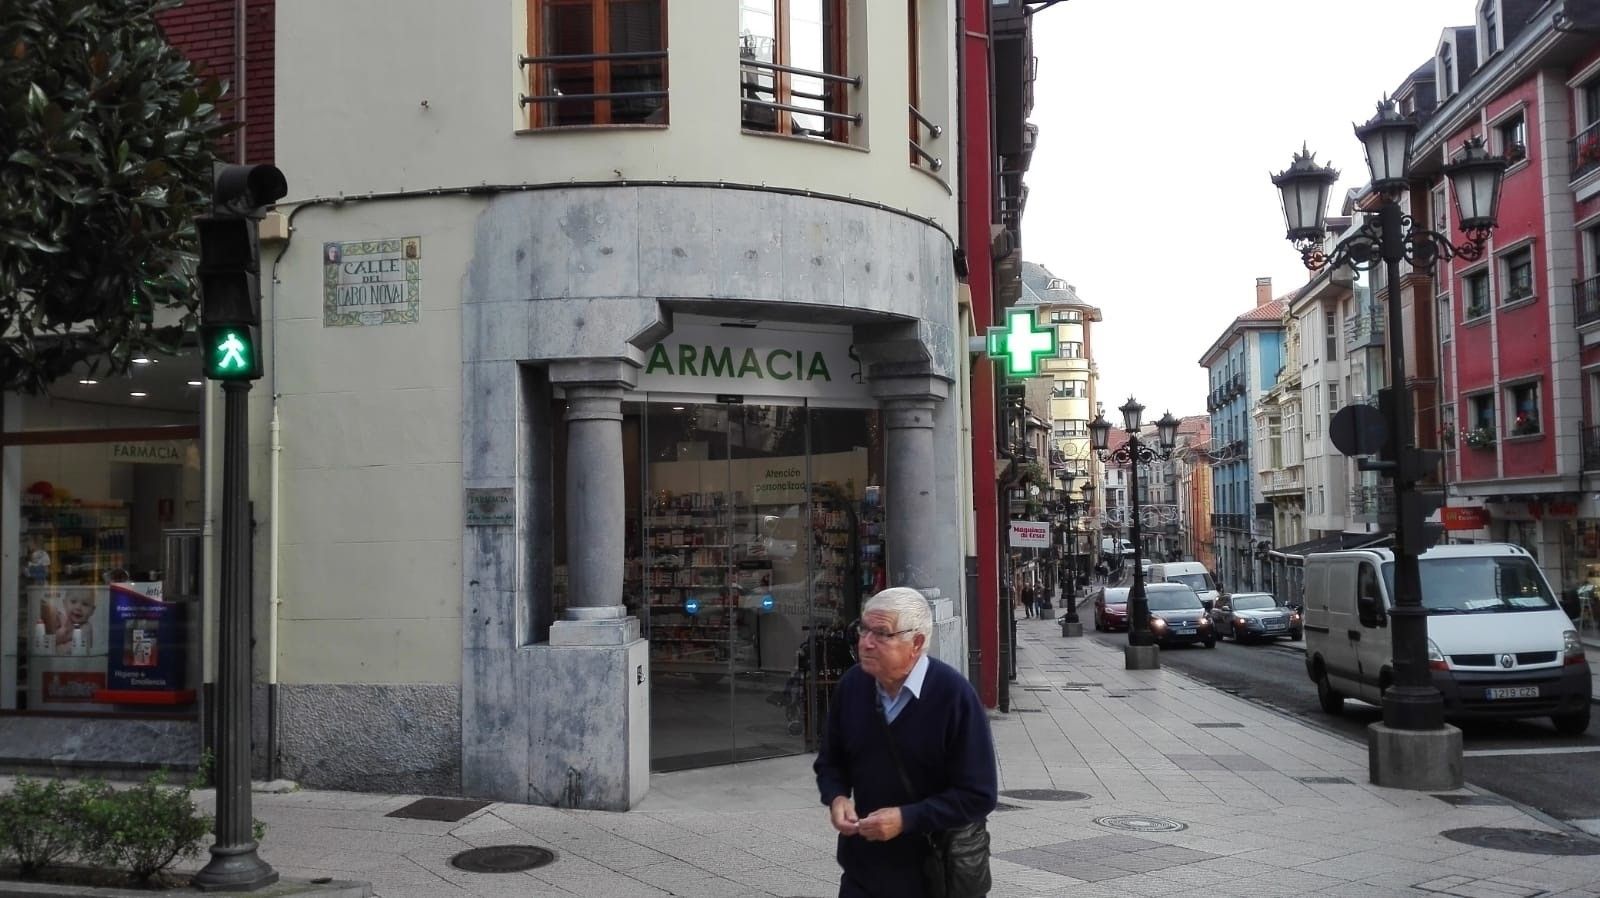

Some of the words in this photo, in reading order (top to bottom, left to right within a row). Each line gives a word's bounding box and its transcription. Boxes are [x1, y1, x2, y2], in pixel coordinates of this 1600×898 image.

[344, 258, 400, 275] CALLE
[362, 275, 381, 284] DEL
[338, 287, 367, 306] CABO
[370, 283, 405, 304] NOVAL
[645, 343, 832, 382] ARMACIA
[114, 445, 178, 459] FARMACIA
[765, 467, 801, 479] Atención
[755, 480, 808, 493] personalizad
[1494, 688, 1516, 699] 1219
